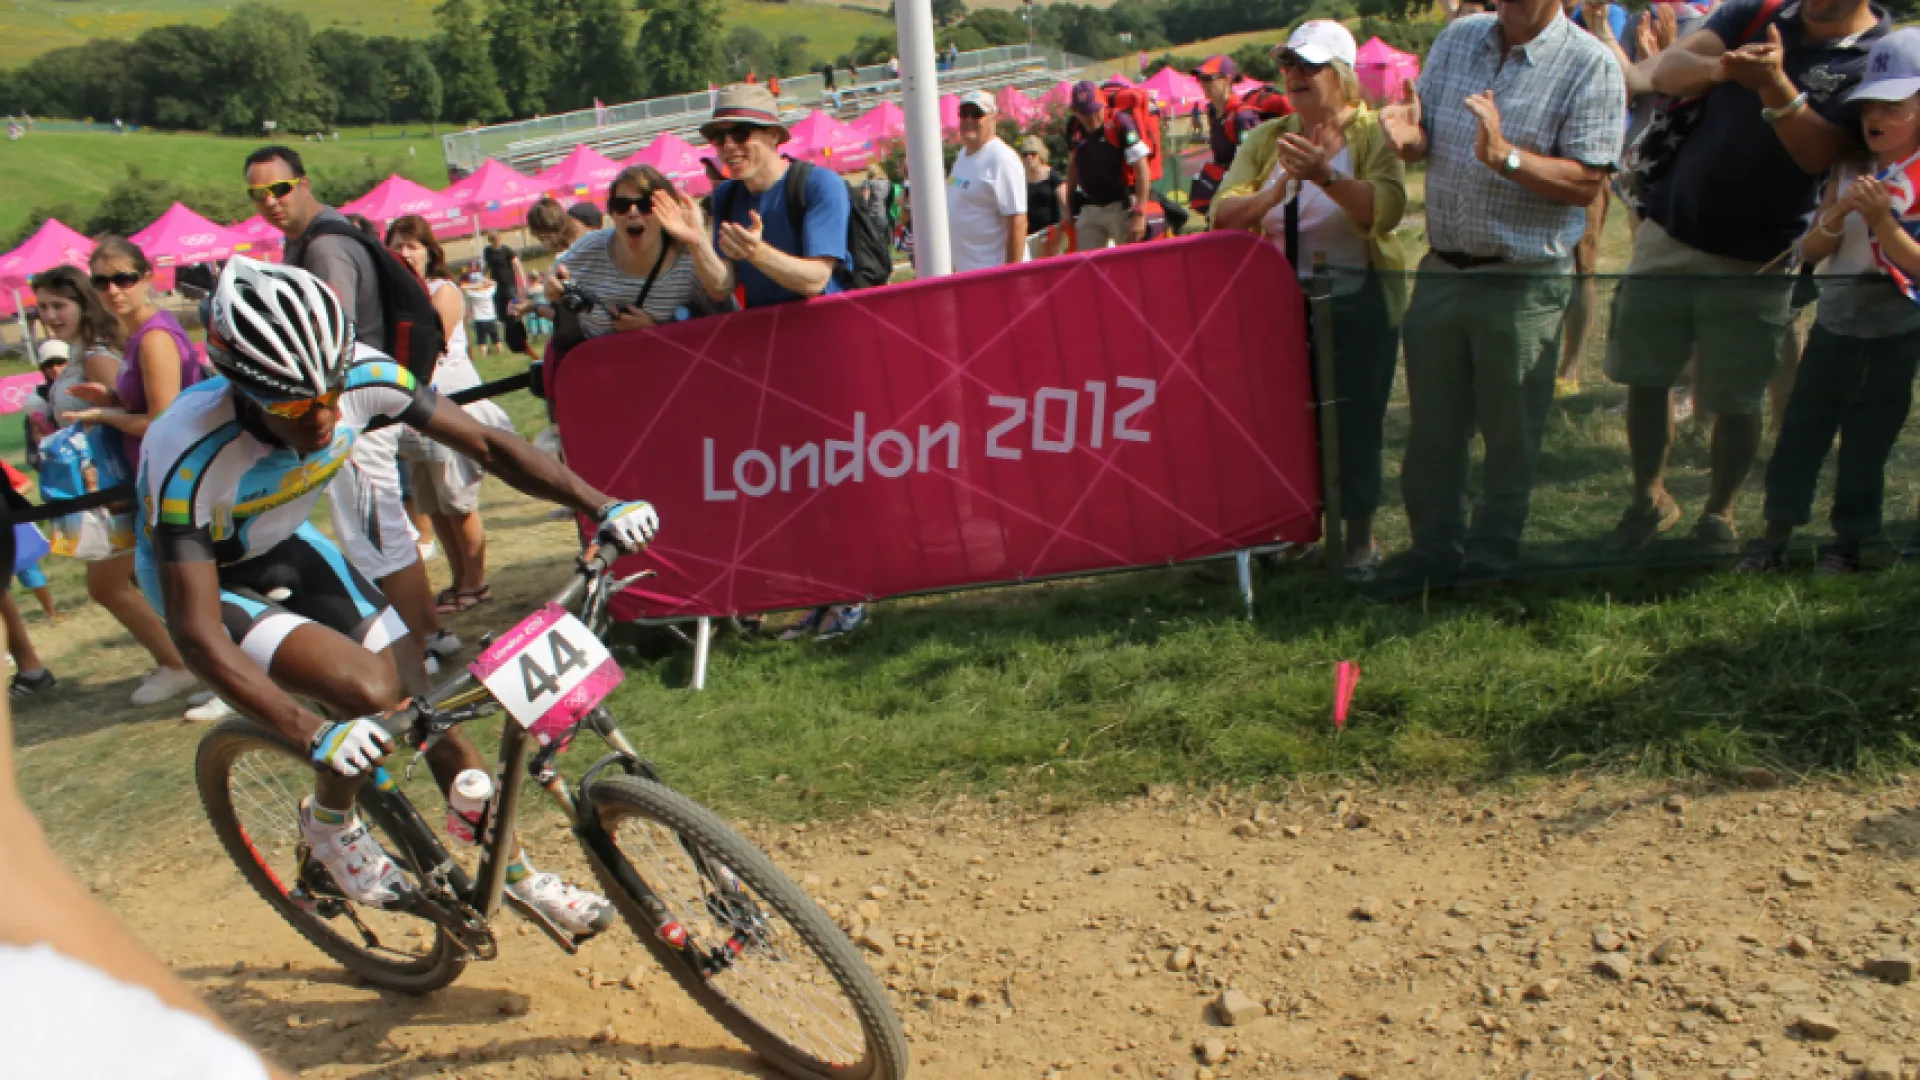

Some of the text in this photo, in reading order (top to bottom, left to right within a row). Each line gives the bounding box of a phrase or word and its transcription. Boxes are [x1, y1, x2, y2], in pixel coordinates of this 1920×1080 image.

[703, 376, 1157, 501] London 2012
[518, 629, 590, 703] 44
